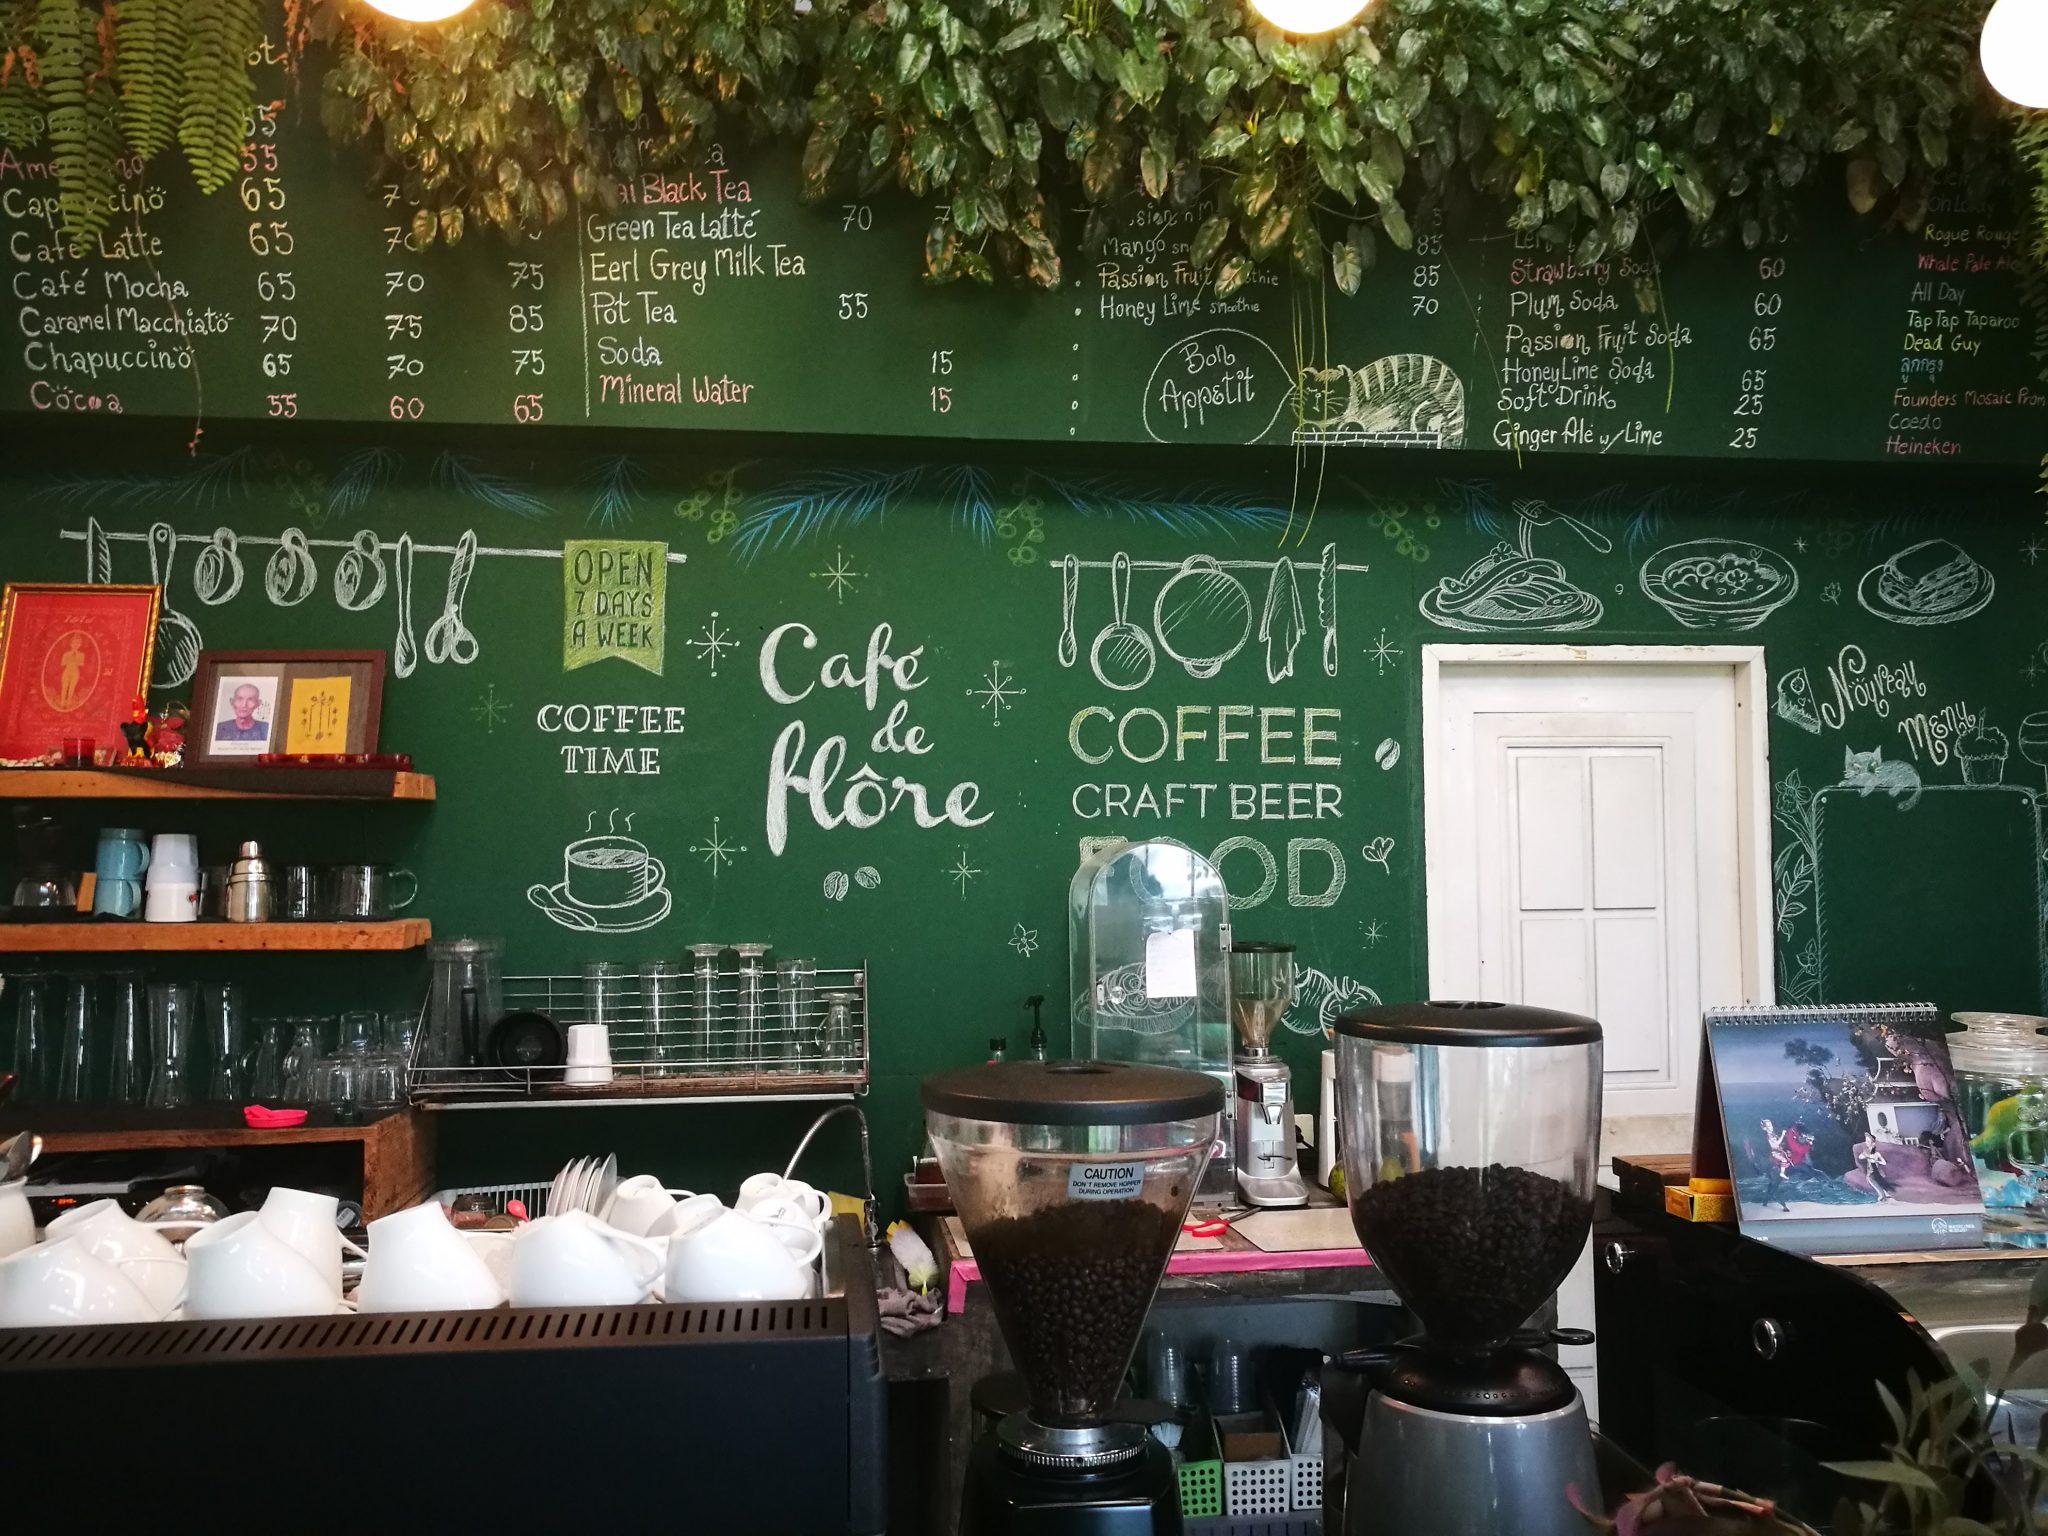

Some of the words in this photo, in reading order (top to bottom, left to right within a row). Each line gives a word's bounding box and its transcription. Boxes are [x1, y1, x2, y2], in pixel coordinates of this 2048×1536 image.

[242, 143, 278, 172] 55
[241, 177, 285, 212] 65
[641, 171, 707, 204] Black
[709, 168, 752, 204] Tea
[587, 212, 655, 244] Green
[658, 210, 696, 240] Tea
[841, 204, 872, 233] 70
[250, 221, 294, 255] 65
[1924, 223, 1969, 247] Rogue
[1102, 236, 1166, 264] Mango
[1917, 253, 1960, 273] Whale
[1964, 253, 1992, 273] Pale
[507, 261, 545, 291] 75
[590, 249, 640, 284] Eerl
[650, 248, 707, 296] Grey
[714, 243, 765, 278] Milk
[766, 243, 806, 277] Tea
[1096, 261, 1170, 291] Passion
[1413, 263, 1442, 288] 85
[1758, 257, 1786, 280] 60
[13, 267, 90, 301] Café
[104, 270, 190, 301] Mocha
[257, 271, 297, 301] 65
[384, 271, 425, 297] 70
[1911, 281, 1933, 302] All
[1937, 281, 1966, 307] Day
[508, 304, 545, 333] 85
[589, 291, 631, 326] Pot
[636, 290, 678, 325] Tea
[838, 292, 869, 320] 55
[1100, 293, 1156, 327] Honey
[1162, 291, 1202, 318] Lime
[1411, 294, 1440, 316] 70
[1510, 291, 1565, 320] Plum
[1570, 290, 1619, 312] Soda
[1753, 291, 1783, 317] 60
[19, 303, 112, 338] Caramel
[259, 314, 298, 344] 70
[384, 314, 423, 341] 75
[1906, 309, 1933, 332] Tap
[1934, 309, 1960, 333] Tap
[1963, 309, 2021, 330] Taparoo
[597, 335, 664, 367] Soda
[1505, 322, 1590, 356] Passion
[1599, 323, 1638, 354] Fruit
[1644, 321, 1693, 348] Soda
[1748, 325, 1779, 352] 65
[1903, 332, 1944, 352] Dead
[1950, 333, 1982, 357] Guy
[262, 352, 293, 378] 65
[386, 353, 425, 380] 70
[511, 348, 546, 376] 75
[931, 349, 953, 375] 15
[1178, 340, 1237, 375] Bon
[1609, 355, 1655, 381] Soda
[599, 372, 683, 405] Mineral
[692, 372, 755, 406] Water
[1740, 368, 1767, 392] 65
[266, 392, 298, 418] 55
[389, 395, 425, 420] 60
[513, 393, 544, 424] 65
[929, 385, 953, 413] 15
[1497, 383, 1548, 412] Soft
[1558, 384, 1616, 410] Drink
[1732, 392, 1765, 416] 25
[1893, 387, 1958, 408] Founders
[1964, 389, 2012, 407] Mosaic
[1492, 418, 1557, 448] Ginger
[1562, 418, 1594, 444] Ale
[1728, 425, 1760, 449] 25
[1885, 435, 1962, 456] Heineken
[573, 549, 653, 587] OPEN
[575, 590, 586, 616] 7
[594, 591, 653, 619] DAYS
[572, 619, 586, 648] A
[598, 621, 655, 650] WEEK
[759, 621, 930, 712] Café
[536, 703, 686, 734] COFFEE
[871, 699, 935, 755] de
[1068, 704, 1343, 767] COFFEE
[560, 745, 661, 776] TIME
[1072, 782, 1218, 820] CRAFT
[1229, 782, 1345, 820] BEER
[1084, 1167, 1134, 1180] CAUTION
[1093, 1181, 1118, 1189] REMOVE
[1078, 1187, 1101, 1195] DURING
[1102, 1187, 1135, 1195] OPERATION
